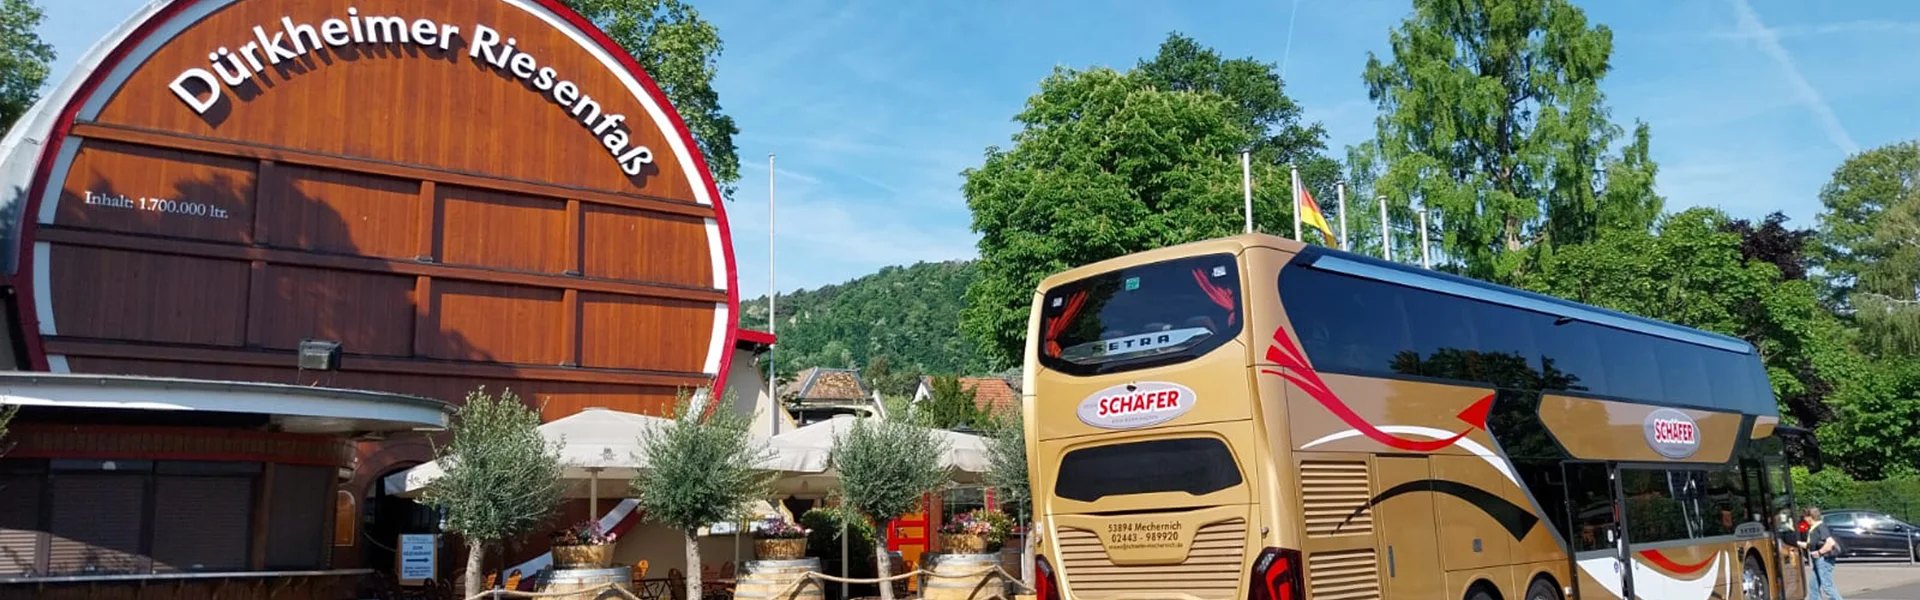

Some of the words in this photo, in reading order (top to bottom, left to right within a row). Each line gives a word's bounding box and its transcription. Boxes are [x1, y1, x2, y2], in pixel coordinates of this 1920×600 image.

[168, 7, 460, 116] Dürkheimer
[468, 24, 654, 178] Riesenfaß
[84, 190, 133, 209] Inhalt:
[138, 197, 206, 217] 1.700.000
[209, 204, 229, 219] ltr.
[1092, 334, 1170, 353] SETRA
[1098, 390, 1180, 416] SCHÄFER
[1108, 523, 1132, 532] 53894
[1134, 521, 1182, 531] Mechernich
[1111, 533, 1137, 543] 02443
[1145, 532, 1178, 541] 989920
